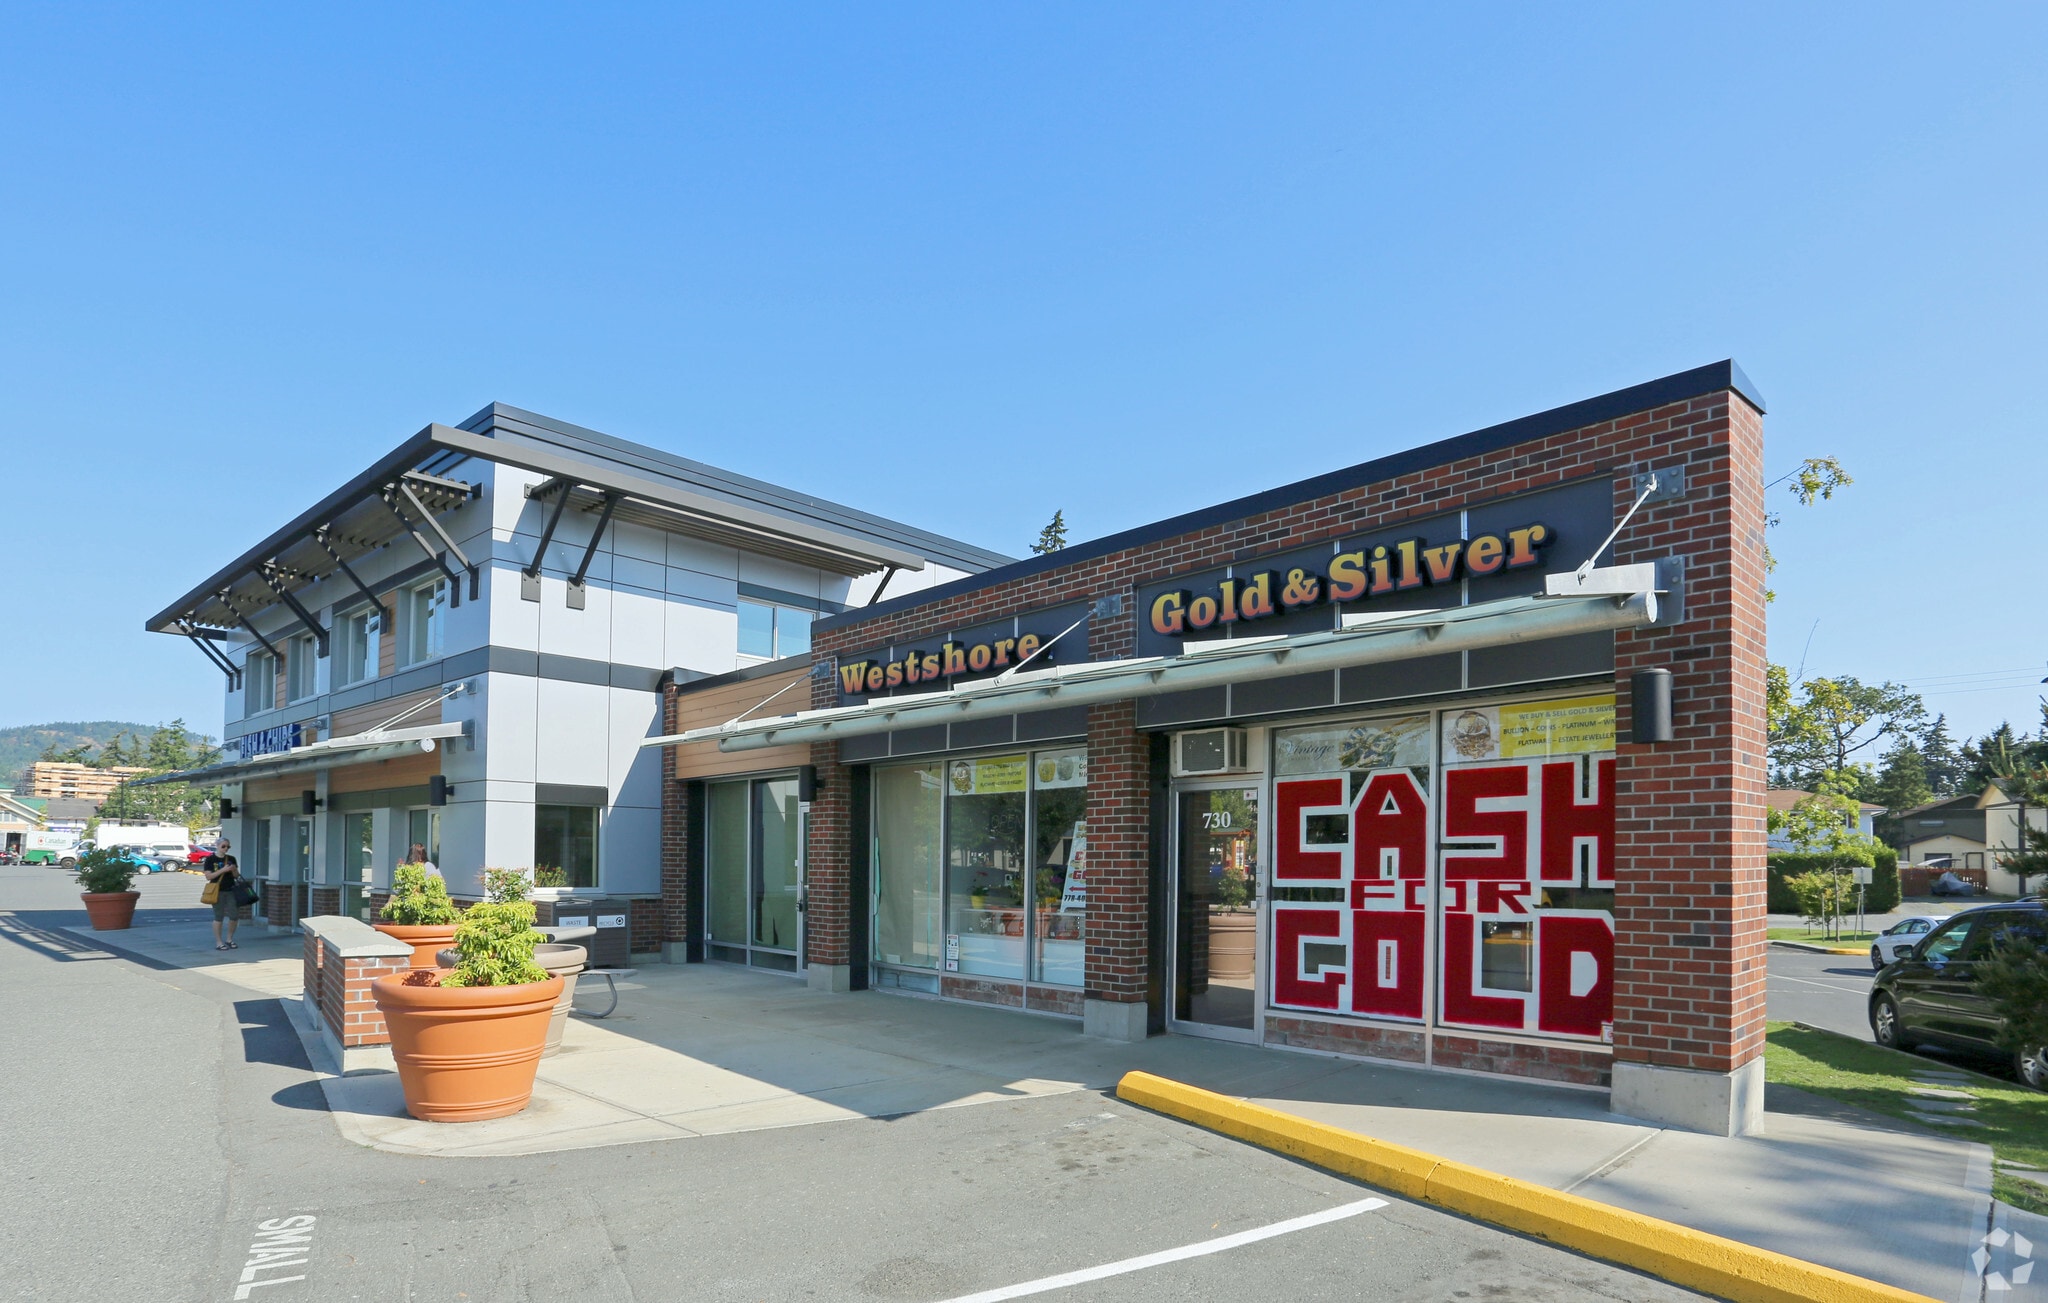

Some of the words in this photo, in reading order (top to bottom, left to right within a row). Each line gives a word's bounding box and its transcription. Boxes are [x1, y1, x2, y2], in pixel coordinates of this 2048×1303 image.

[1150, 570, 1272, 635] Gold
[1281, 567, 1319, 606] &
[1328, 522, 1548, 603] Silver
[840, 632, 1040, 697] Westshore
[241, 733, 258, 758] FISH
[266, 723, 293, 753] CHIPS
[1503, 726, 1530, 734] BULLION
[1562, 720, 1596, 729] PLATINUM
[1202, 812, 1232, 828] 730
[1276, 758, 1616, 880] CASH
[1350, 879, 1532, 914] FOR
[1275, 909, 1615, 1037] GOLD
[233, 1214, 317, 1301] SMALL
